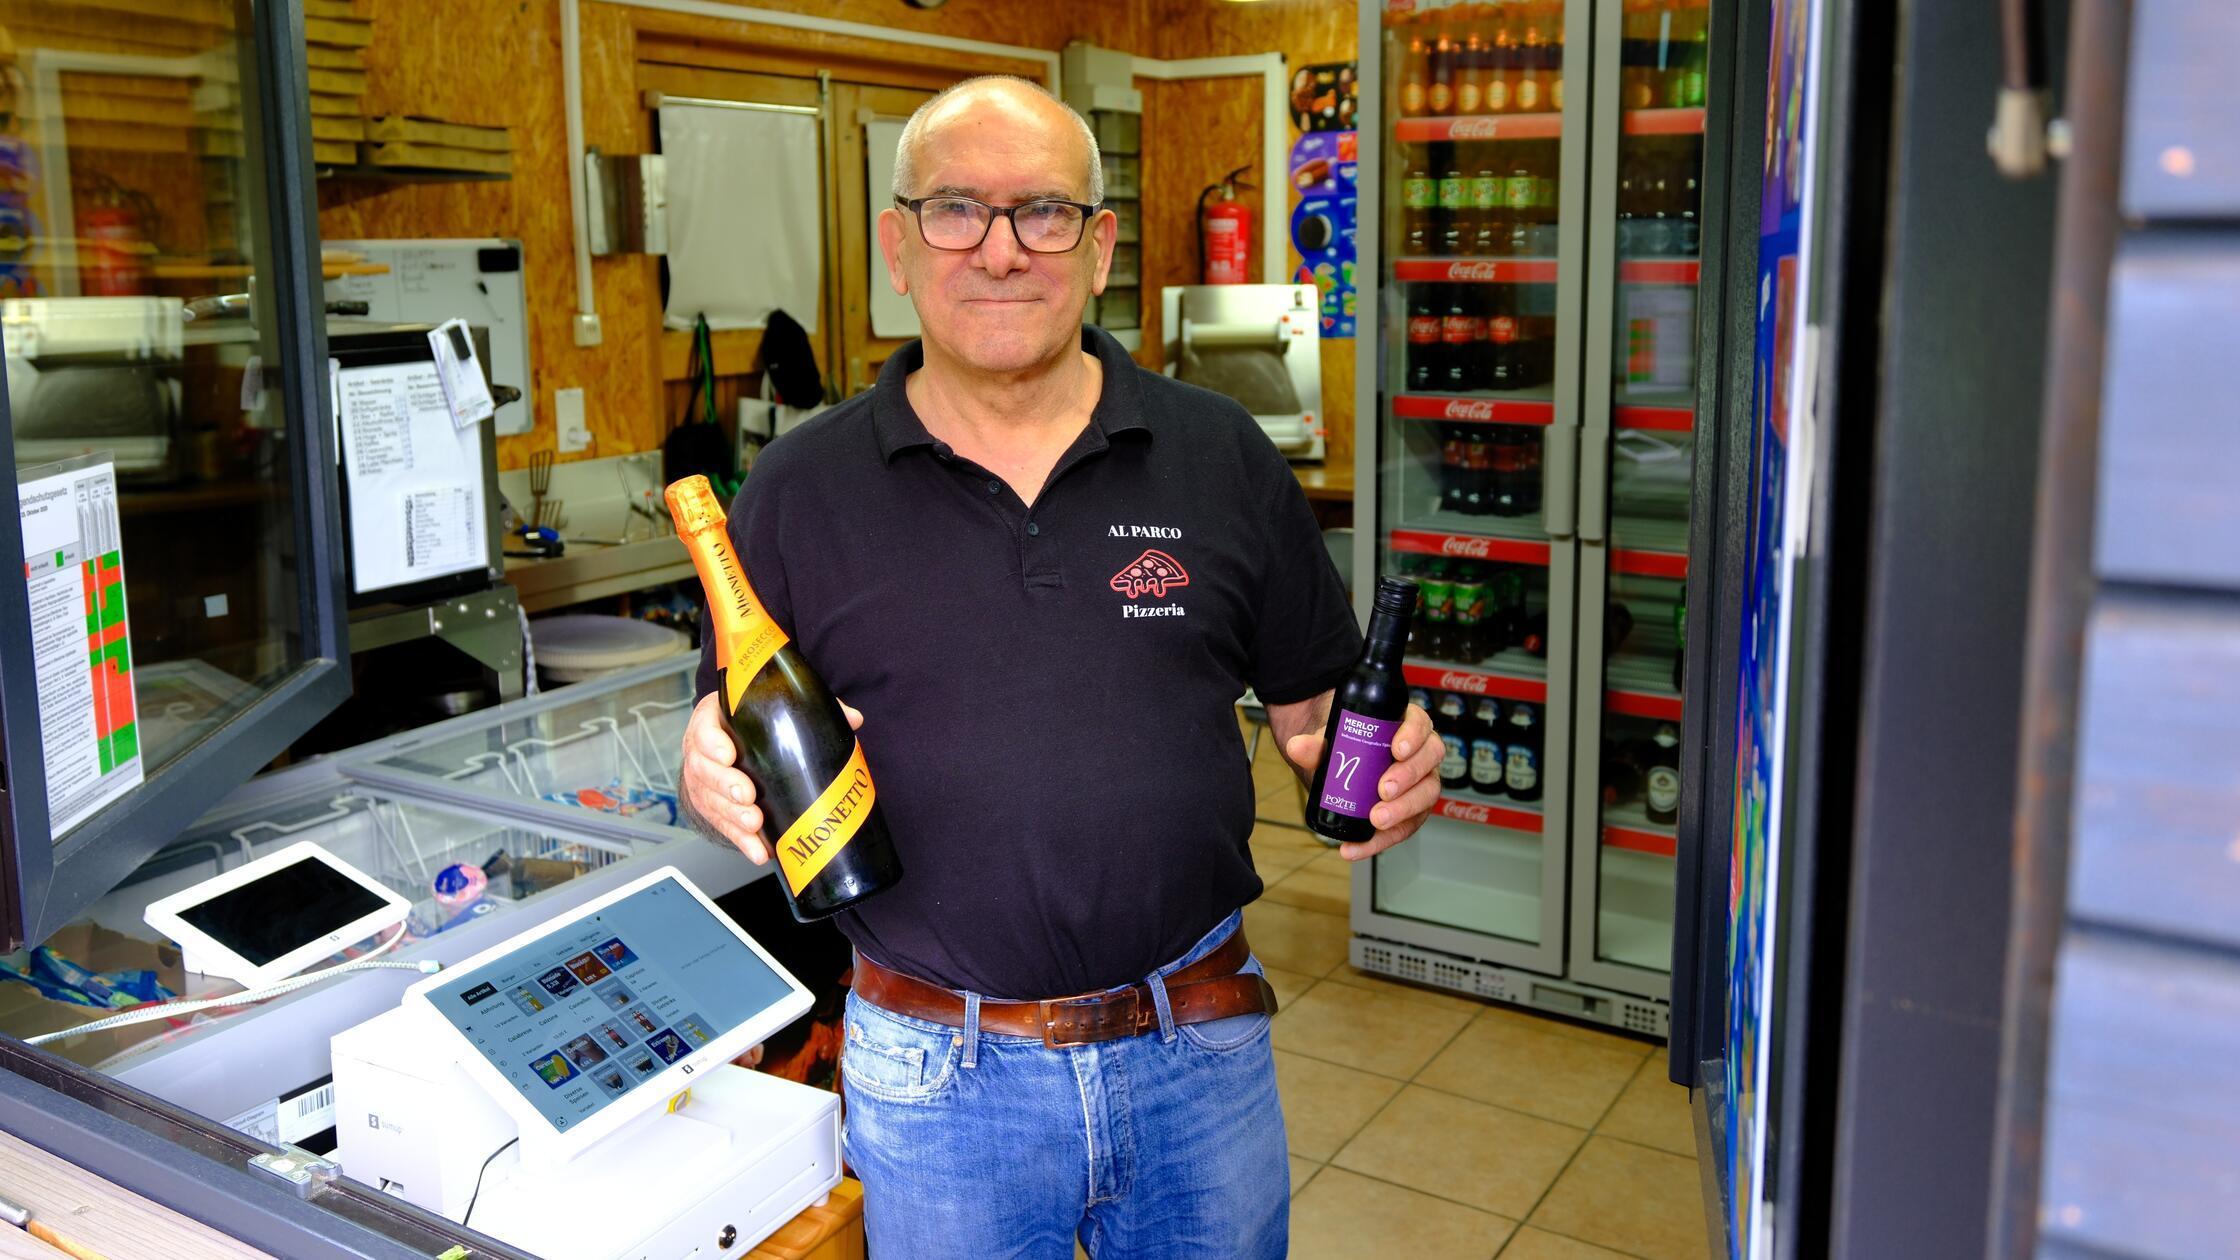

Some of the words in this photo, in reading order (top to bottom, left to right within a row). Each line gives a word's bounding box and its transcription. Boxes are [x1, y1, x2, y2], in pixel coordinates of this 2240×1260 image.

[1108, 525, 1128, 537] AL
[1130, 525, 1182, 539] PARCO
[1122, 603, 1186, 618] Pizzeria
[738, 626, 776, 666] PROSECCO
[1343, 724, 1374, 738] VENETO
[1344, 717, 1380, 732] MERLOT
[538, 1014, 558, 1026] Calzone
[507, 1027, 532, 1042] Calabrese
[564, 1087, 582, 1099] Diverse
[570, 1092, 590, 1105] Speisen
